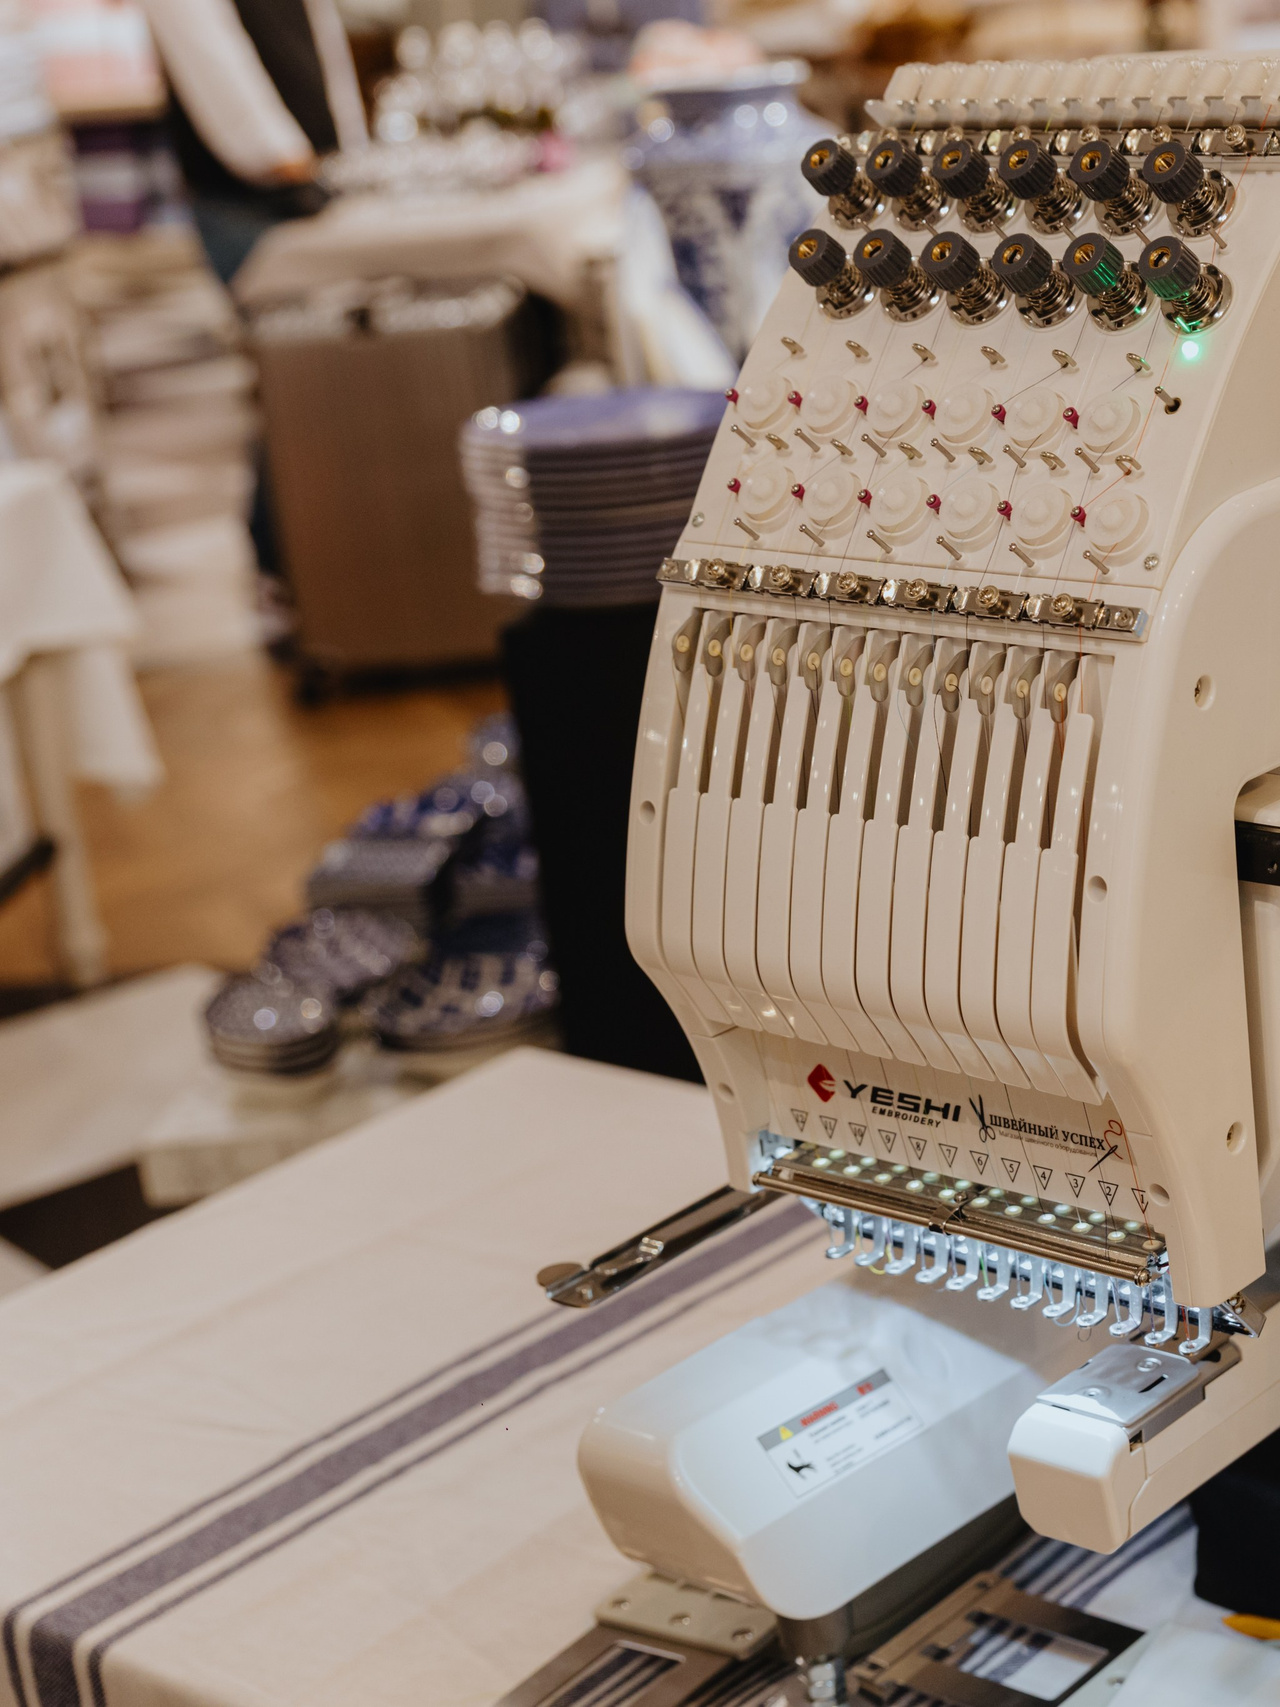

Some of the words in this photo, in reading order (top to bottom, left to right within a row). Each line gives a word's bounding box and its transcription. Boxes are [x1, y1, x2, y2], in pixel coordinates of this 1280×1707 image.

[843, 1079, 962, 1122] YESHI
[871, 1106, 942, 1128] EMBROIDERY
[989, 1114, 1060, 1140] ШВЕЙНЫЙ
[1061, 1130, 1106, 1151] УСПЕХ
